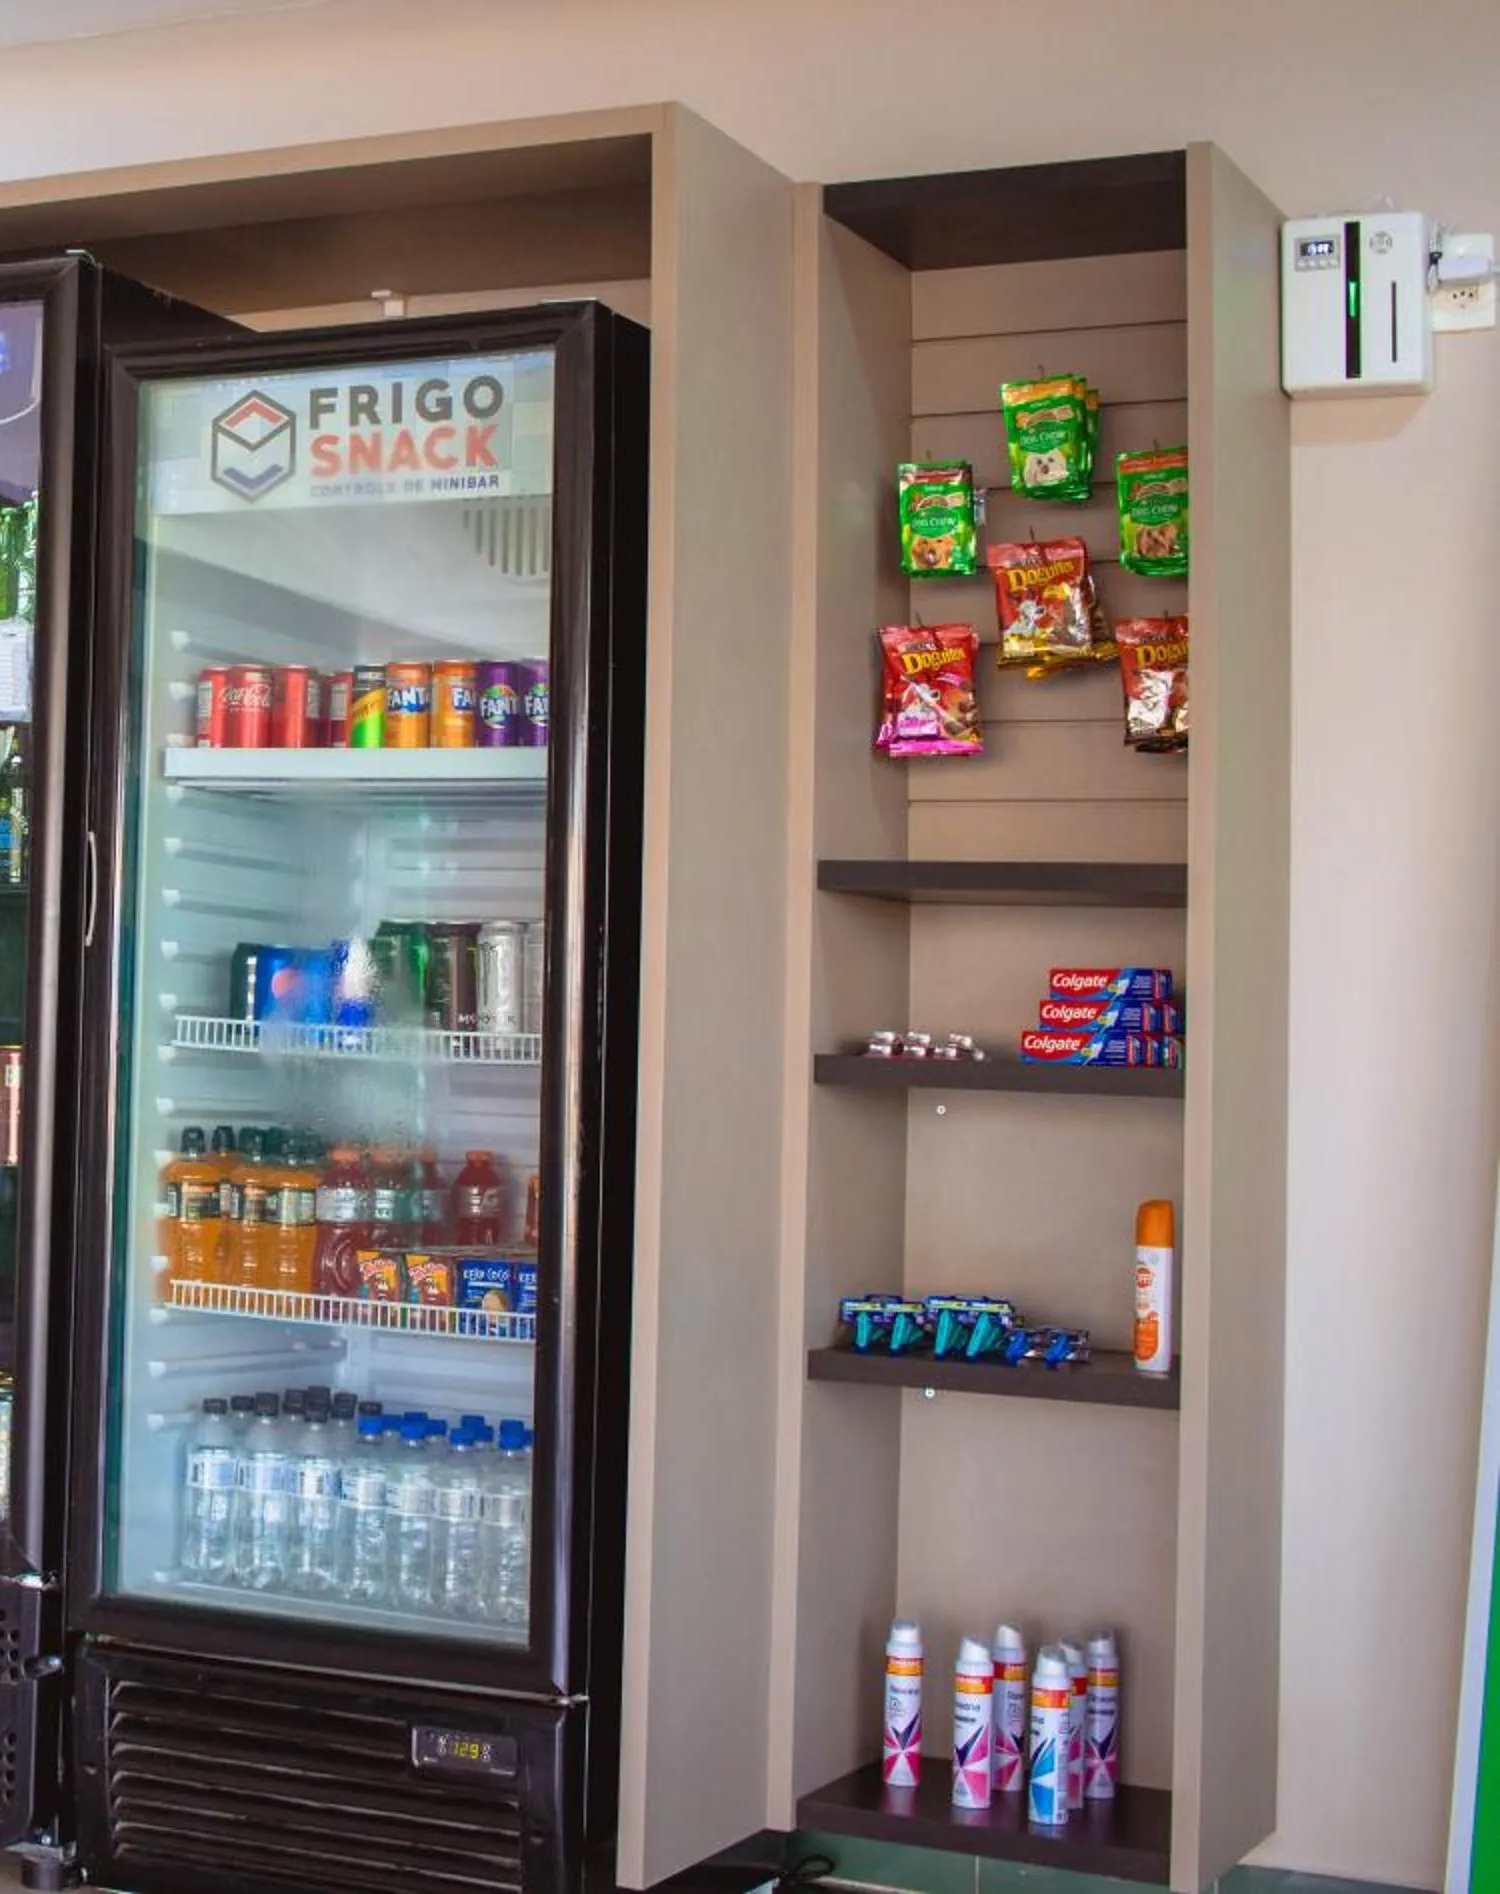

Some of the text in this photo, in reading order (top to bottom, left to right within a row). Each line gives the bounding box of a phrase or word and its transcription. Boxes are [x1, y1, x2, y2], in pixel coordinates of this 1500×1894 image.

[309, 375, 504, 430] FRIGO
[310, 423, 500, 478] SNACK
[430, 474, 499, 491] MINIBAR
[1052, 973, 1108, 991] Colgate
[1041, 1004, 1097, 1023] Colgate
[1023, 1035, 1081, 1054] Colgate
